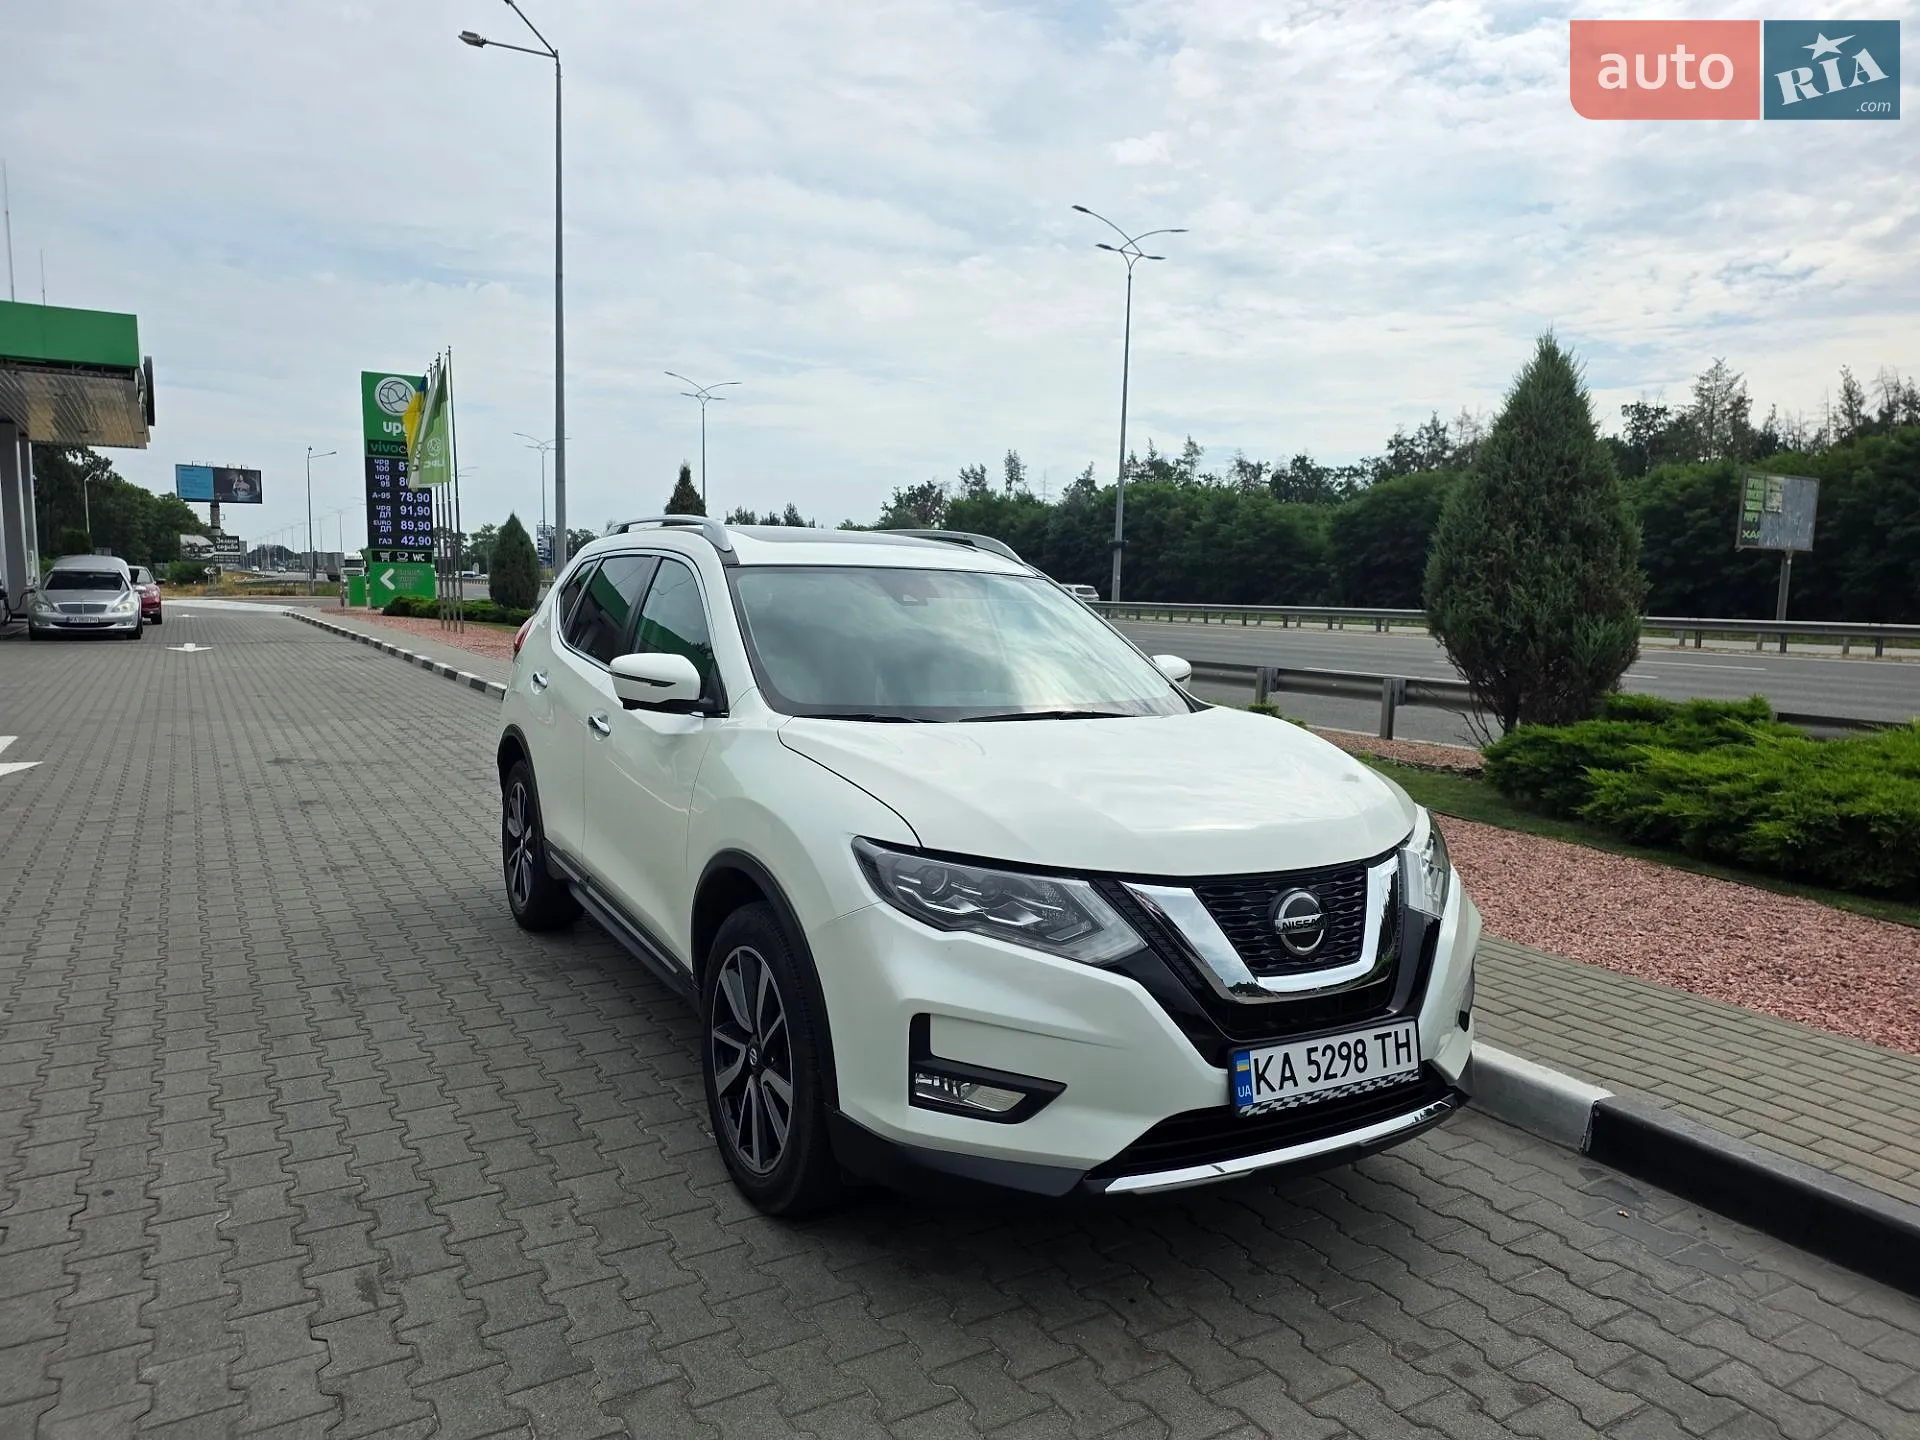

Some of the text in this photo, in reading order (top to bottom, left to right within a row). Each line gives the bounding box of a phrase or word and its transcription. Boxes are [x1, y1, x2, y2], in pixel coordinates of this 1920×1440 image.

[399, 492, 430, 503] 78,90
[400, 505, 430, 516] 91,90
[400, 536, 431, 547] 42,90
[412, 553, 425, 562] WC
[1253, 1028, 1412, 1095] KA 5298 TH
[1237, 1085, 1252, 1098] UA
